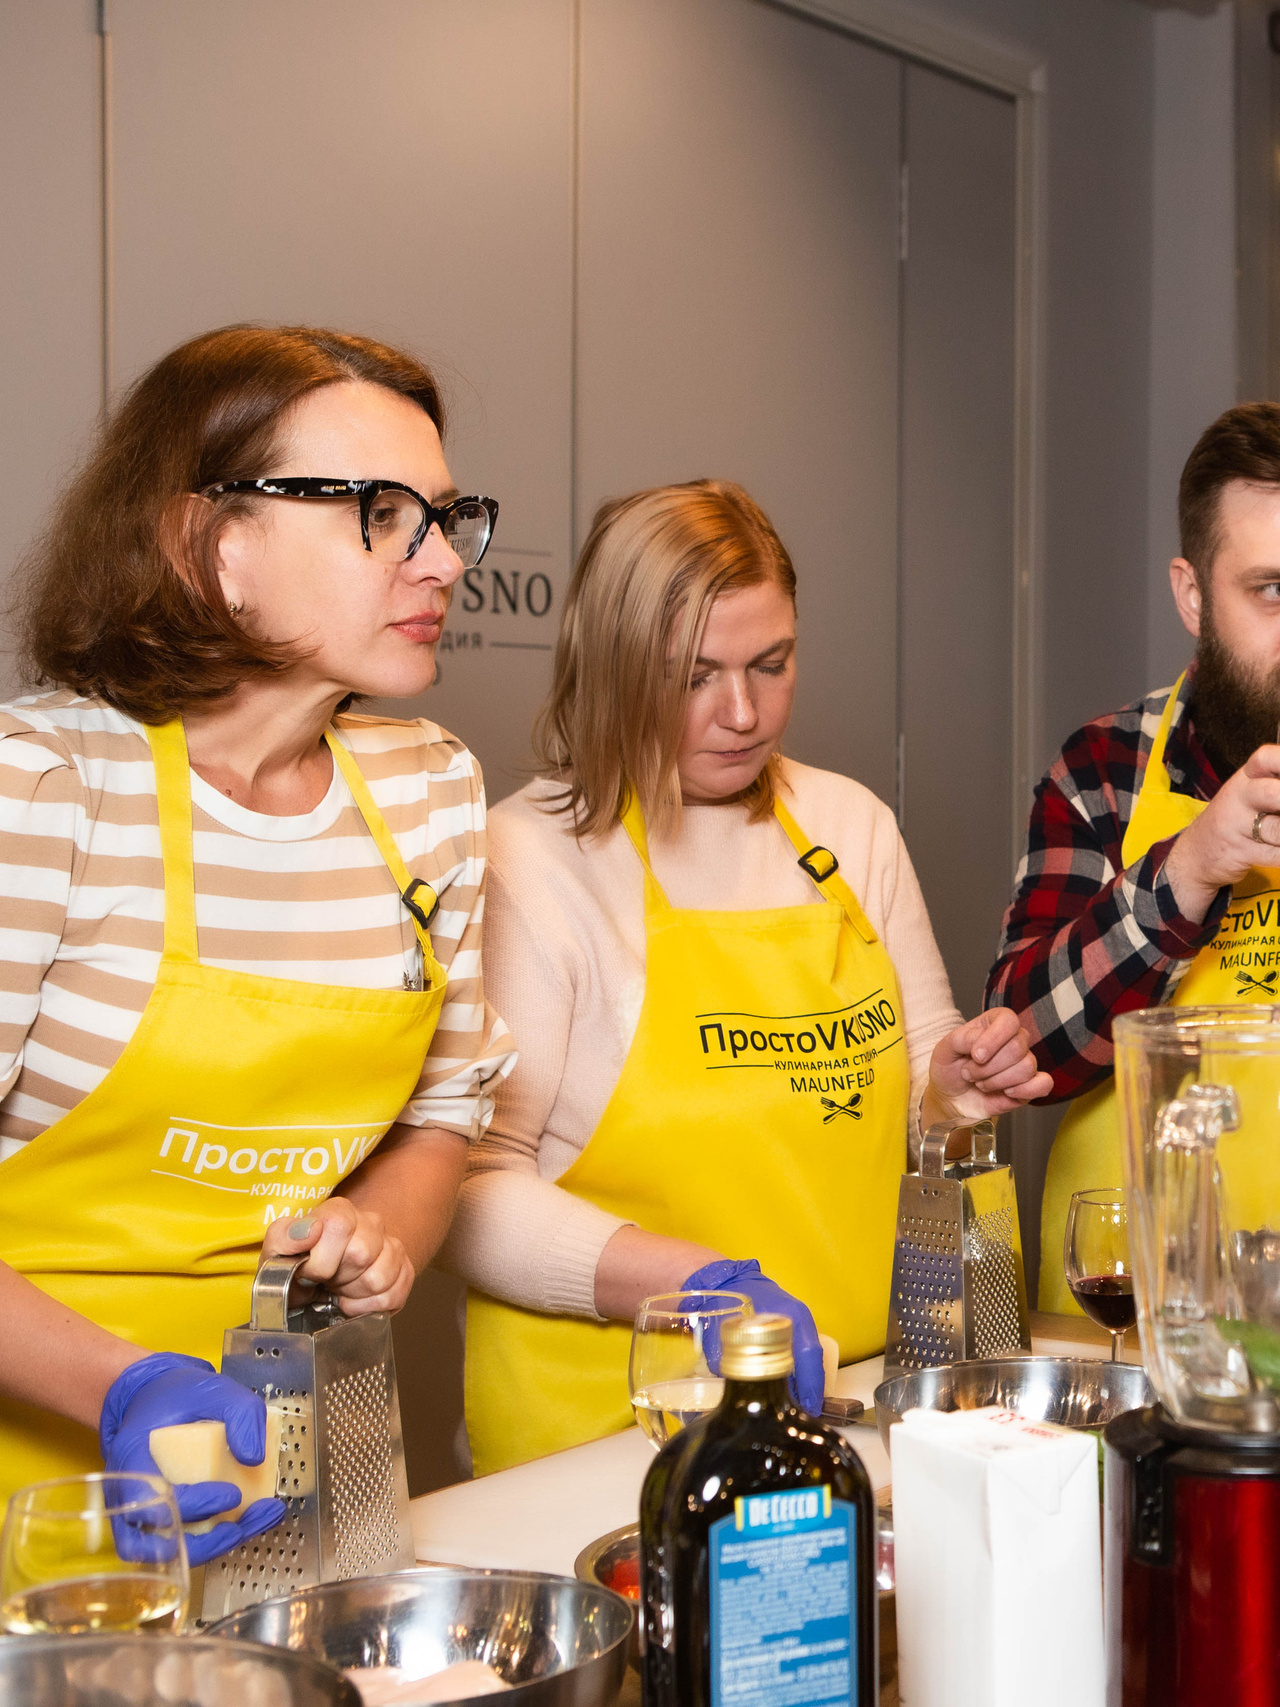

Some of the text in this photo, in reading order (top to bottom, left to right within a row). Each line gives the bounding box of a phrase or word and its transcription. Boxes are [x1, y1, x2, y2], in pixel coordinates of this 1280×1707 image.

[699, 999, 897, 1059] ПростоVKUSNO
[774, 1057, 850, 1072] КУЛИНАРНАЯ
[790, 1068, 875, 1093] MAUNFELD
